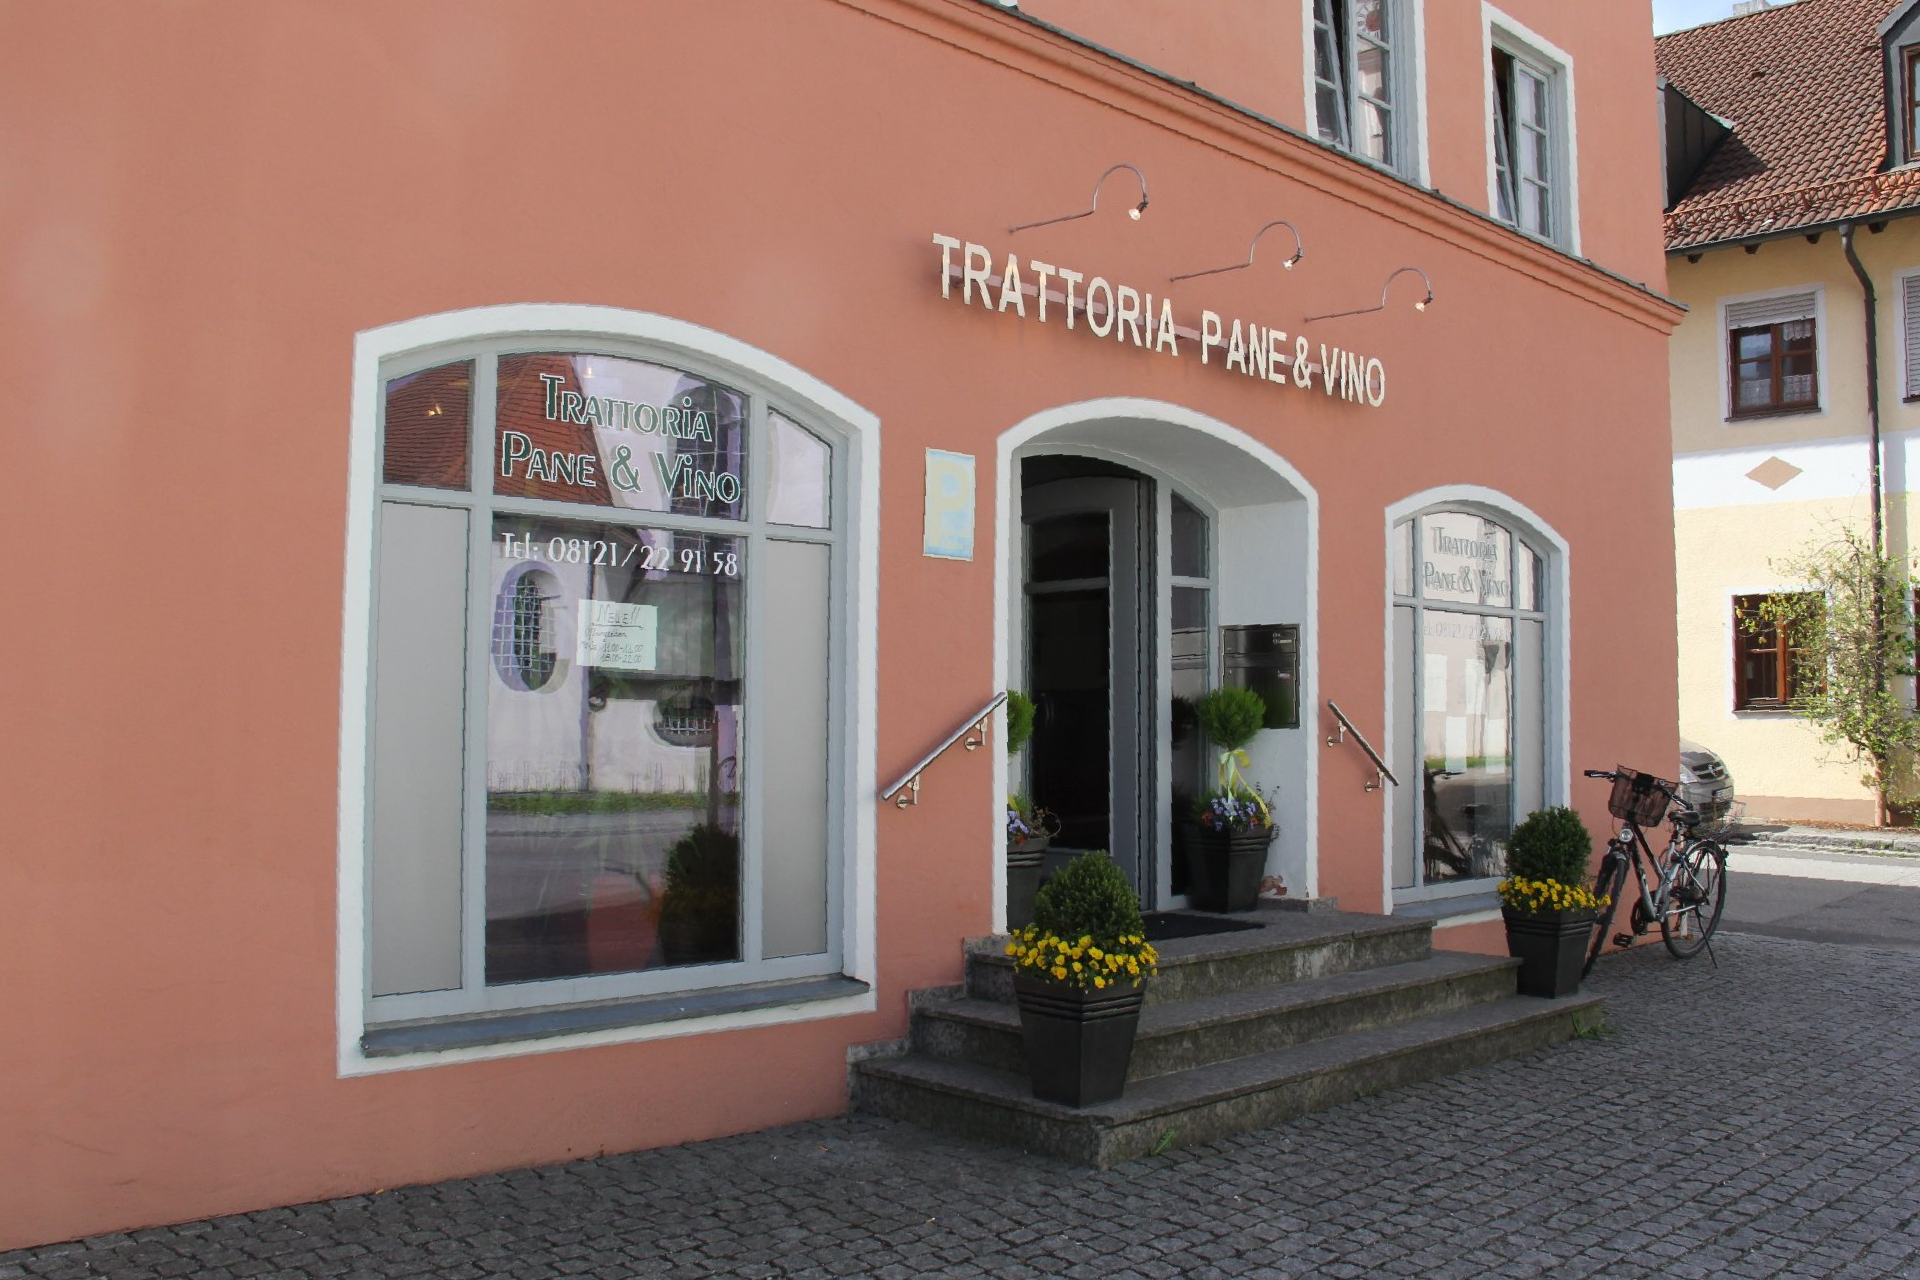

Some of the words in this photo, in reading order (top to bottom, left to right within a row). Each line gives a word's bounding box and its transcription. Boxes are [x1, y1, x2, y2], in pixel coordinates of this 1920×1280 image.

[932, 232, 1179, 357] TRATTORIA
[1201, 309, 1287, 385] PANE
[1293, 336, 1313, 390] &
[1320, 343, 1386, 409] VINO
[502, 431, 597, 487] PANE
[611, 444, 642, 493] &
[681, 548, 701, 573] 91
[713, 552, 738, 576] 58
